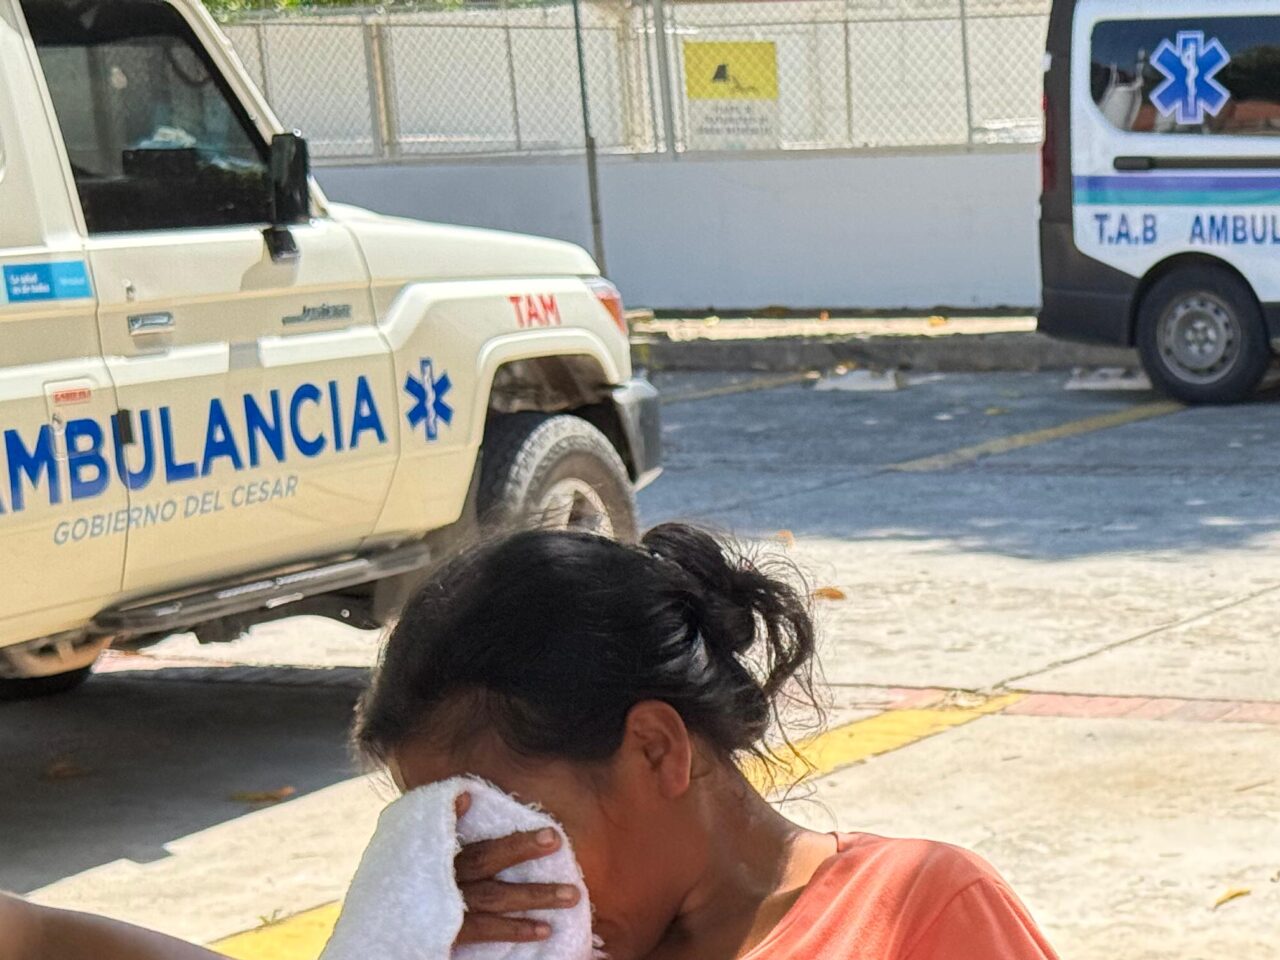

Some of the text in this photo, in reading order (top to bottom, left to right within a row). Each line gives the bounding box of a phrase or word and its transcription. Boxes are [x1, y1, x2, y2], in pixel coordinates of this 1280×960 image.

[1094, 213, 1157, 245] T.A.B
[508, 294, 562, 328] TAM
[0, 375, 388, 515] MBULANCIA
[53, 475, 299, 546] GOBIERNO DEL CESAR
